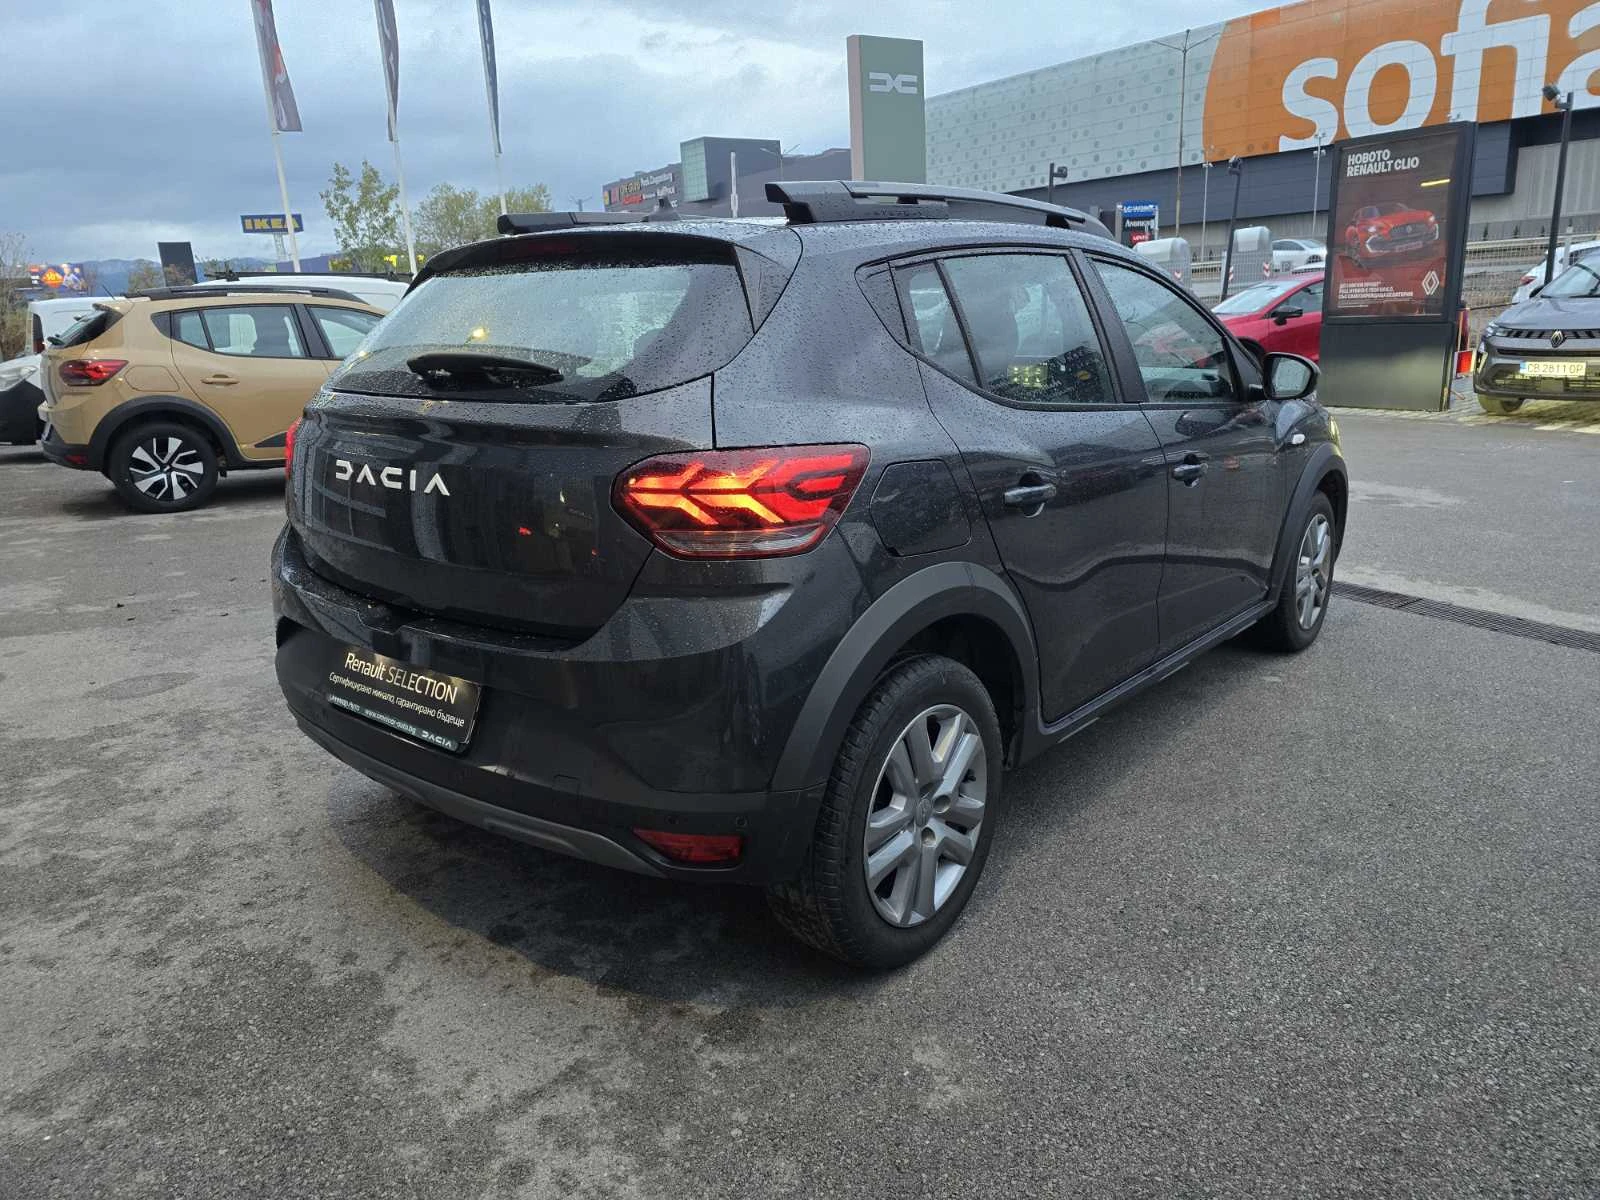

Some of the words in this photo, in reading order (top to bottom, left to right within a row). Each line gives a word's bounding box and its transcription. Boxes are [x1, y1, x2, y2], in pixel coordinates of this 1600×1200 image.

[1346, 160, 1394, 177] RENAULT
[1394, 156, 1420, 171] CLIO
[245, 217, 300, 230] IKEA
[335, 459, 451, 496] DACIA
[345, 652, 387, 681] Renault
[386, 666, 458, 704] SELECTION
[328, 671, 372, 695] Сертифицирано
[395, 697, 437, 717] гарантирано
[436, 708, 465, 727] бъдеще
[421, 730, 452, 748] DACIA
